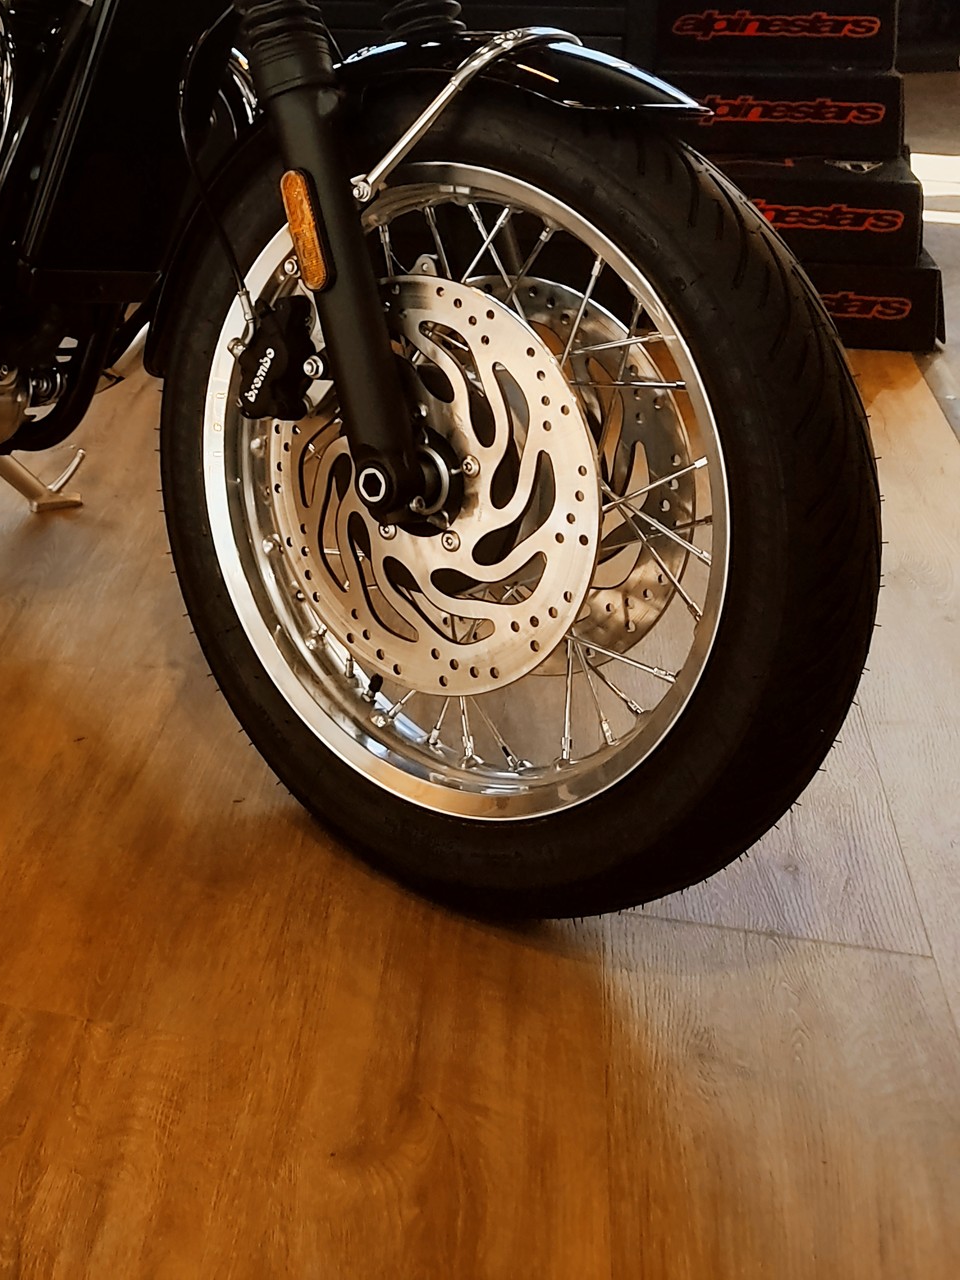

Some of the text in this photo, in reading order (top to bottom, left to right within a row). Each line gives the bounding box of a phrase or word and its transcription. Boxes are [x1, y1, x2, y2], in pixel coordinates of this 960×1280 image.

[671, 9, 881, 41] alpinestars
[696, 95, 886, 126] lpinestars
[244, 347, 275, 403] brembo
